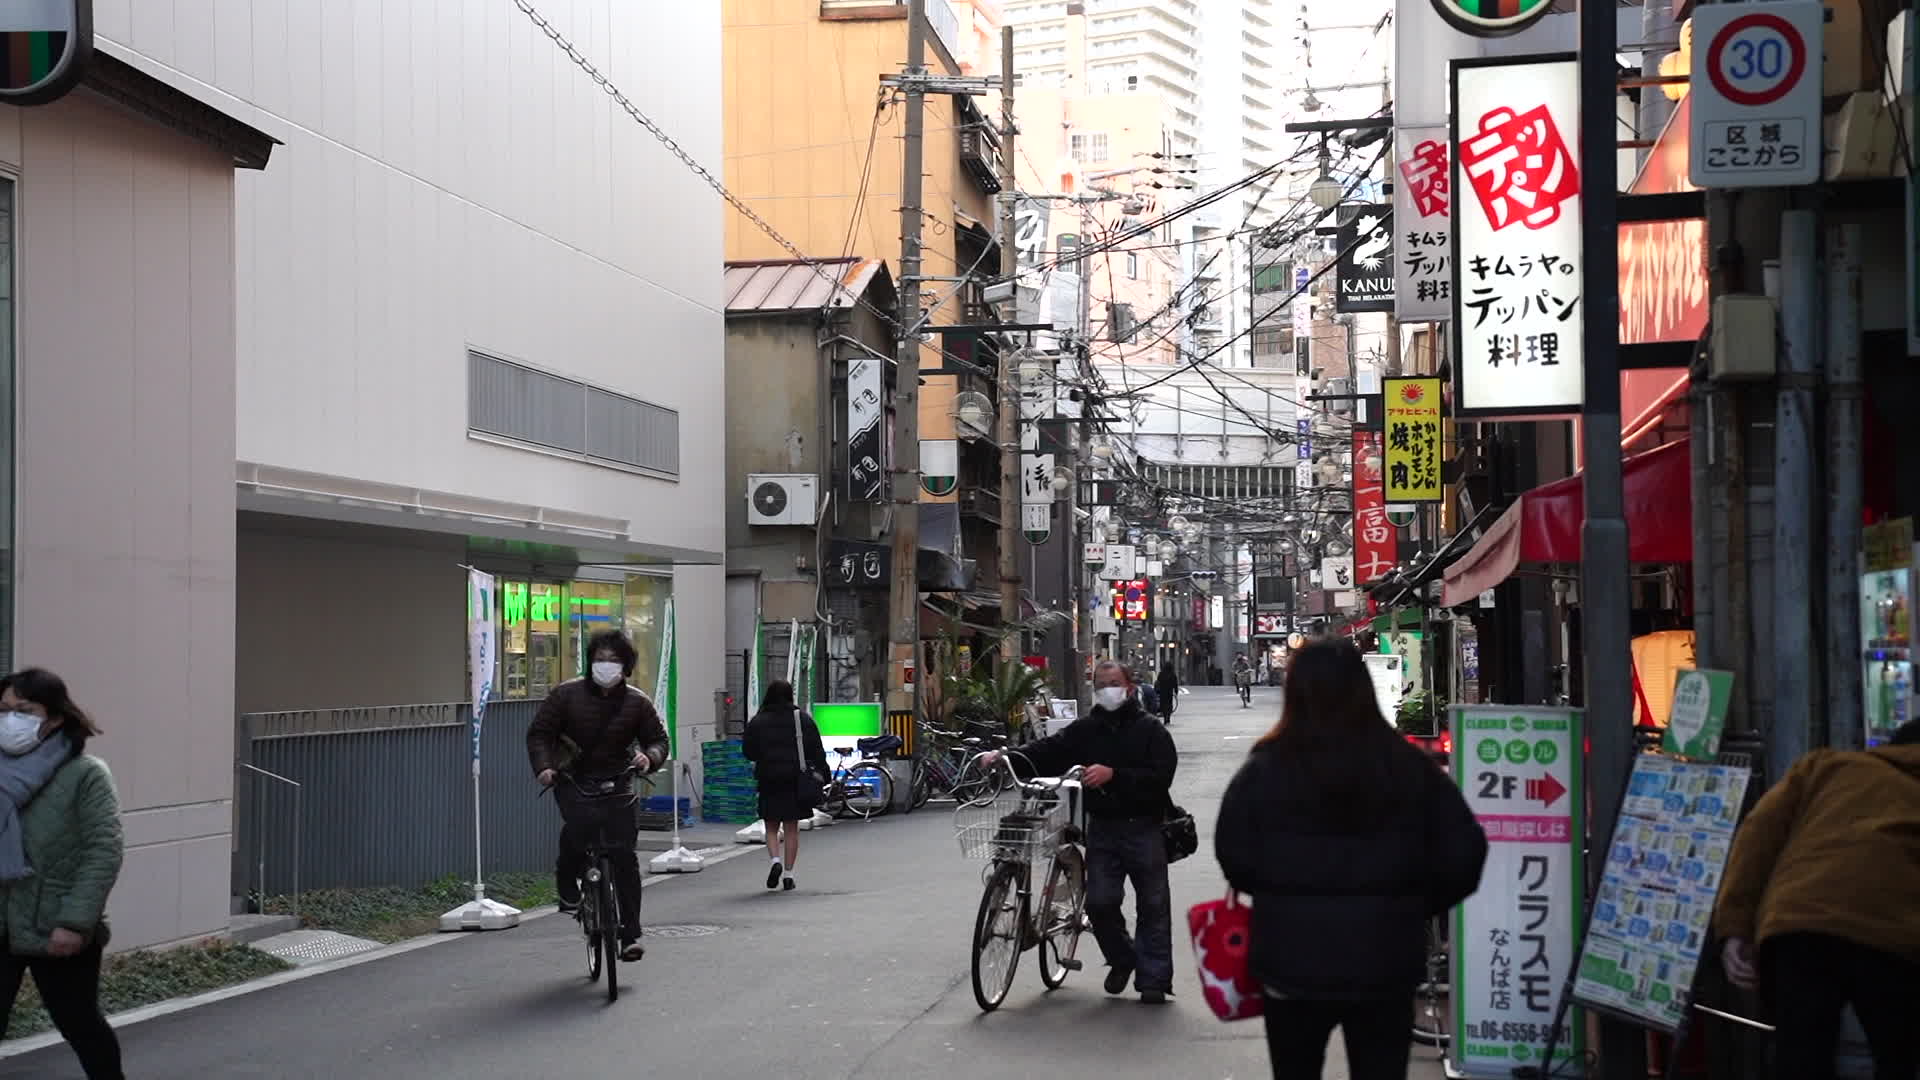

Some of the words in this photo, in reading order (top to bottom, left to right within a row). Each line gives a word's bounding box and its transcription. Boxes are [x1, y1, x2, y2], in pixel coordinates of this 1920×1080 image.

[1729, 38, 1783, 80] 30
[1727, 123, 1781, 145] 区域
[1707, 144, 1801, 168] ここから
[1468, 253, 1575, 281] キムラヤの
[1463, 287, 1581, 330] テッパン
[1487, 332, 1559, 367] 料理
[1389, 422, 1409, 490] 焼肉
[1411, 420, 1424, 489] ホルモン
[1424, 420, 1437, 489] かすうどん
[1356, 485, 1395, 582] 一富士
[1477, 771, 1519, 799] 2F
[1518, 855, 1551, 1013] クラスモ
[1489, 928, 1512, 1010] なんば店
